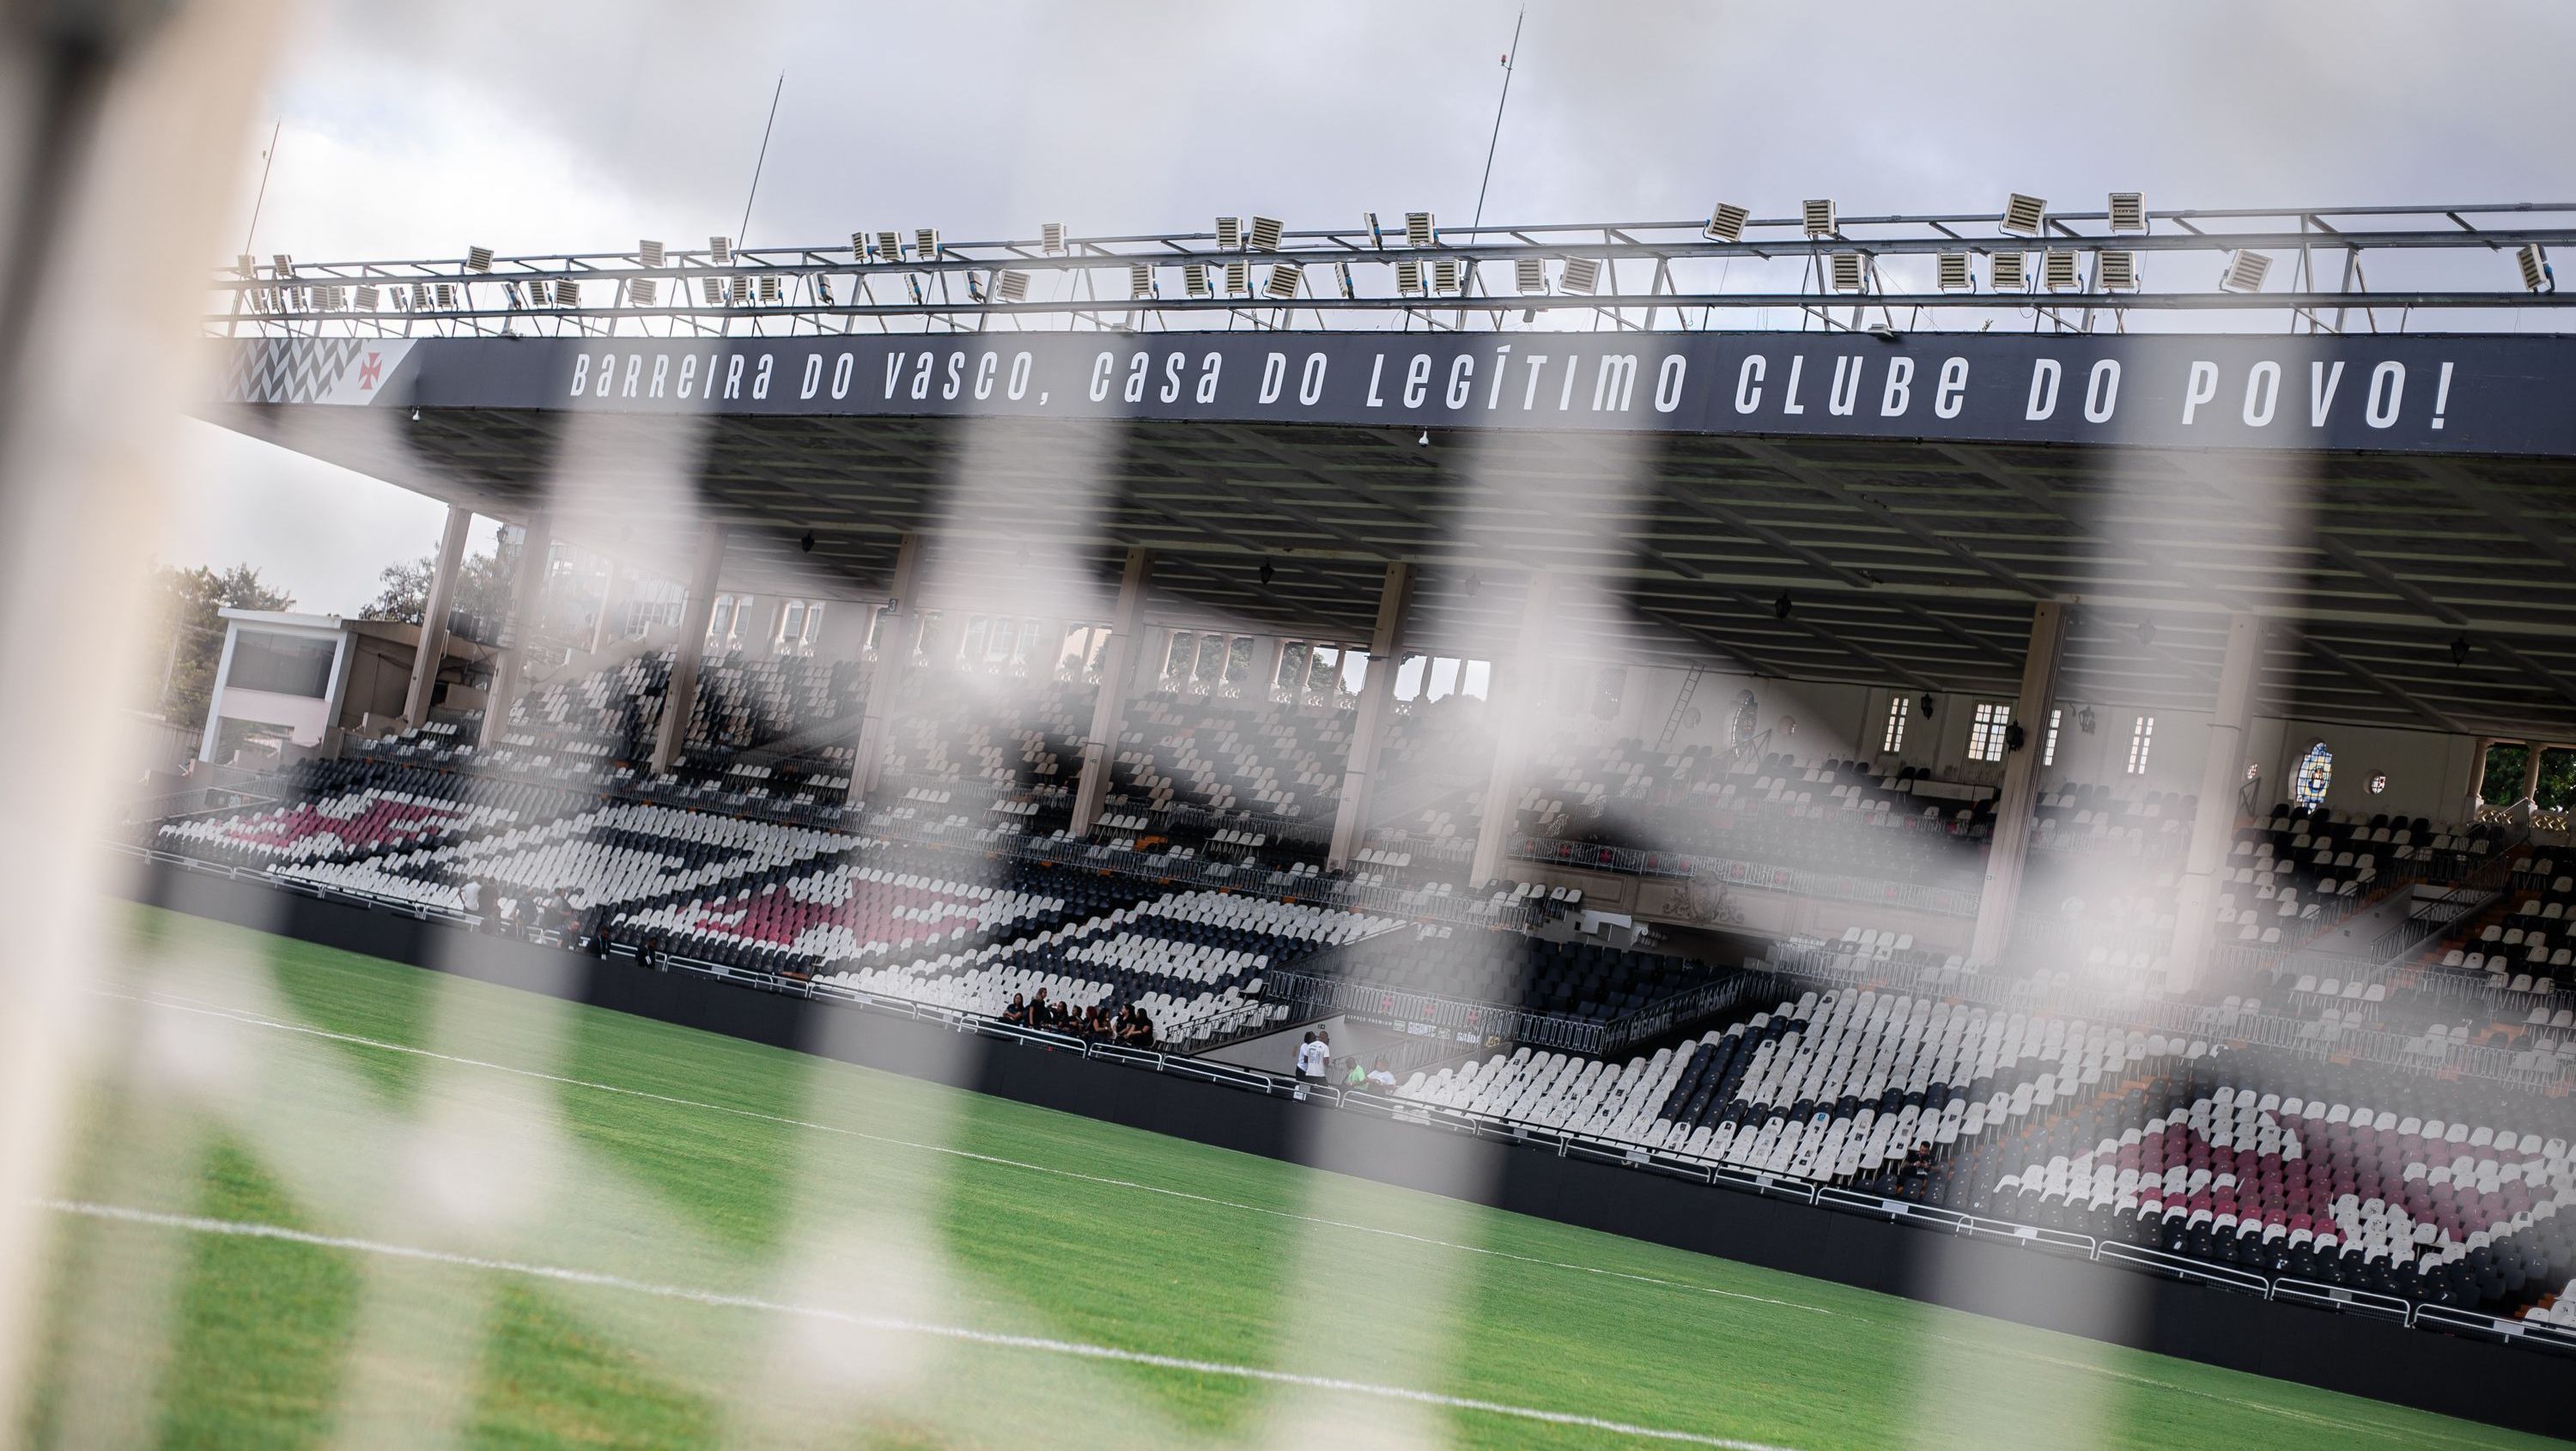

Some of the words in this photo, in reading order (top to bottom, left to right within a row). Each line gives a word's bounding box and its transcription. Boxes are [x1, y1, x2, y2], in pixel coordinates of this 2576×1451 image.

[799, 352, 854, 400] DO
[1258, 352, 1327, 406] DO
[2025, 358, 2121, 424] DO
[2182, 360, 2455, 430] POVO!
